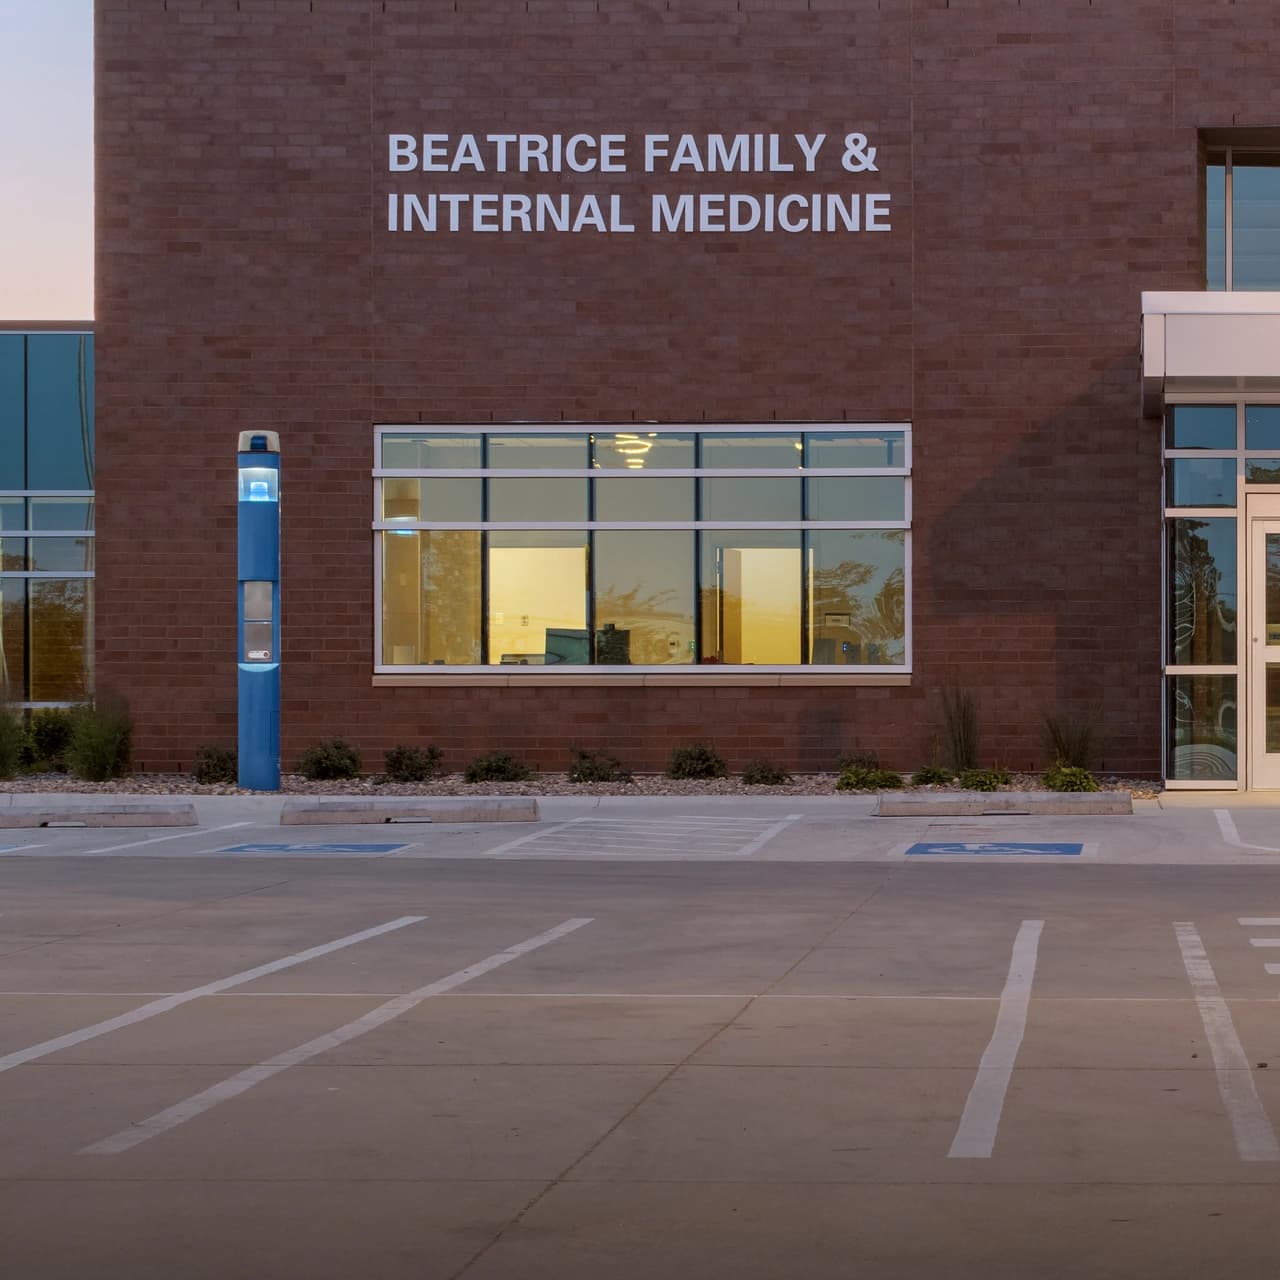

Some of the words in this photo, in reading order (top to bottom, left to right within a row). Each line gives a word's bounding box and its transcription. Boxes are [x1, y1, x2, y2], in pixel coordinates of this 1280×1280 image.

[388, 133, 627, 173] BEATRICE
[644, 133, 827, 172] FAMILY
[841, 132, 879, 172] &
[388, 193, 635, 233] INTERNAL
[651, 193, 892, 233] MEDICINE
